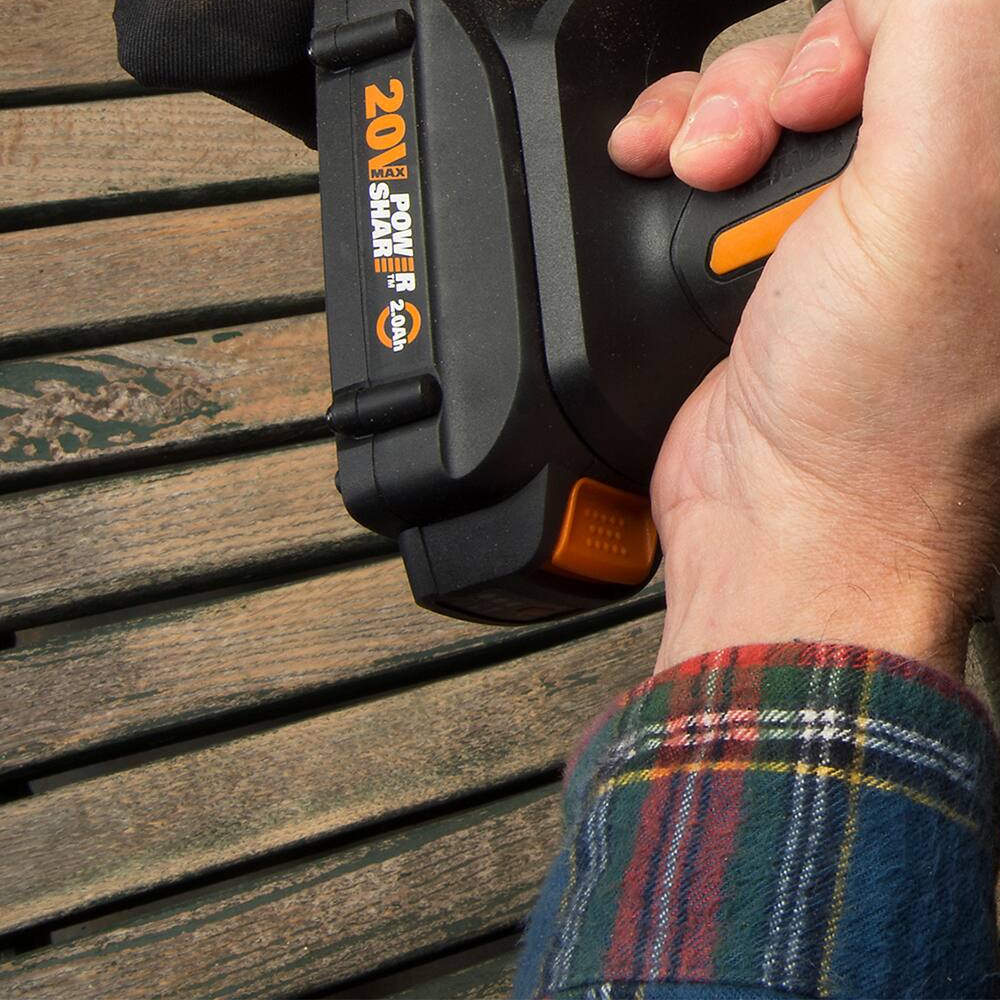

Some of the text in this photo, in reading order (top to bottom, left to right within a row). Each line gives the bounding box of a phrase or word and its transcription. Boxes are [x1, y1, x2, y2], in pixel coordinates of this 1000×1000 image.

[364, 77, 408, 181] 20V
[370, 166, 407, 180] MAX
[369, 182, 394, 273] SHARE
[390, 193, 416, 292] POWER
[389, 299, 408, 352] 2.0Ah
